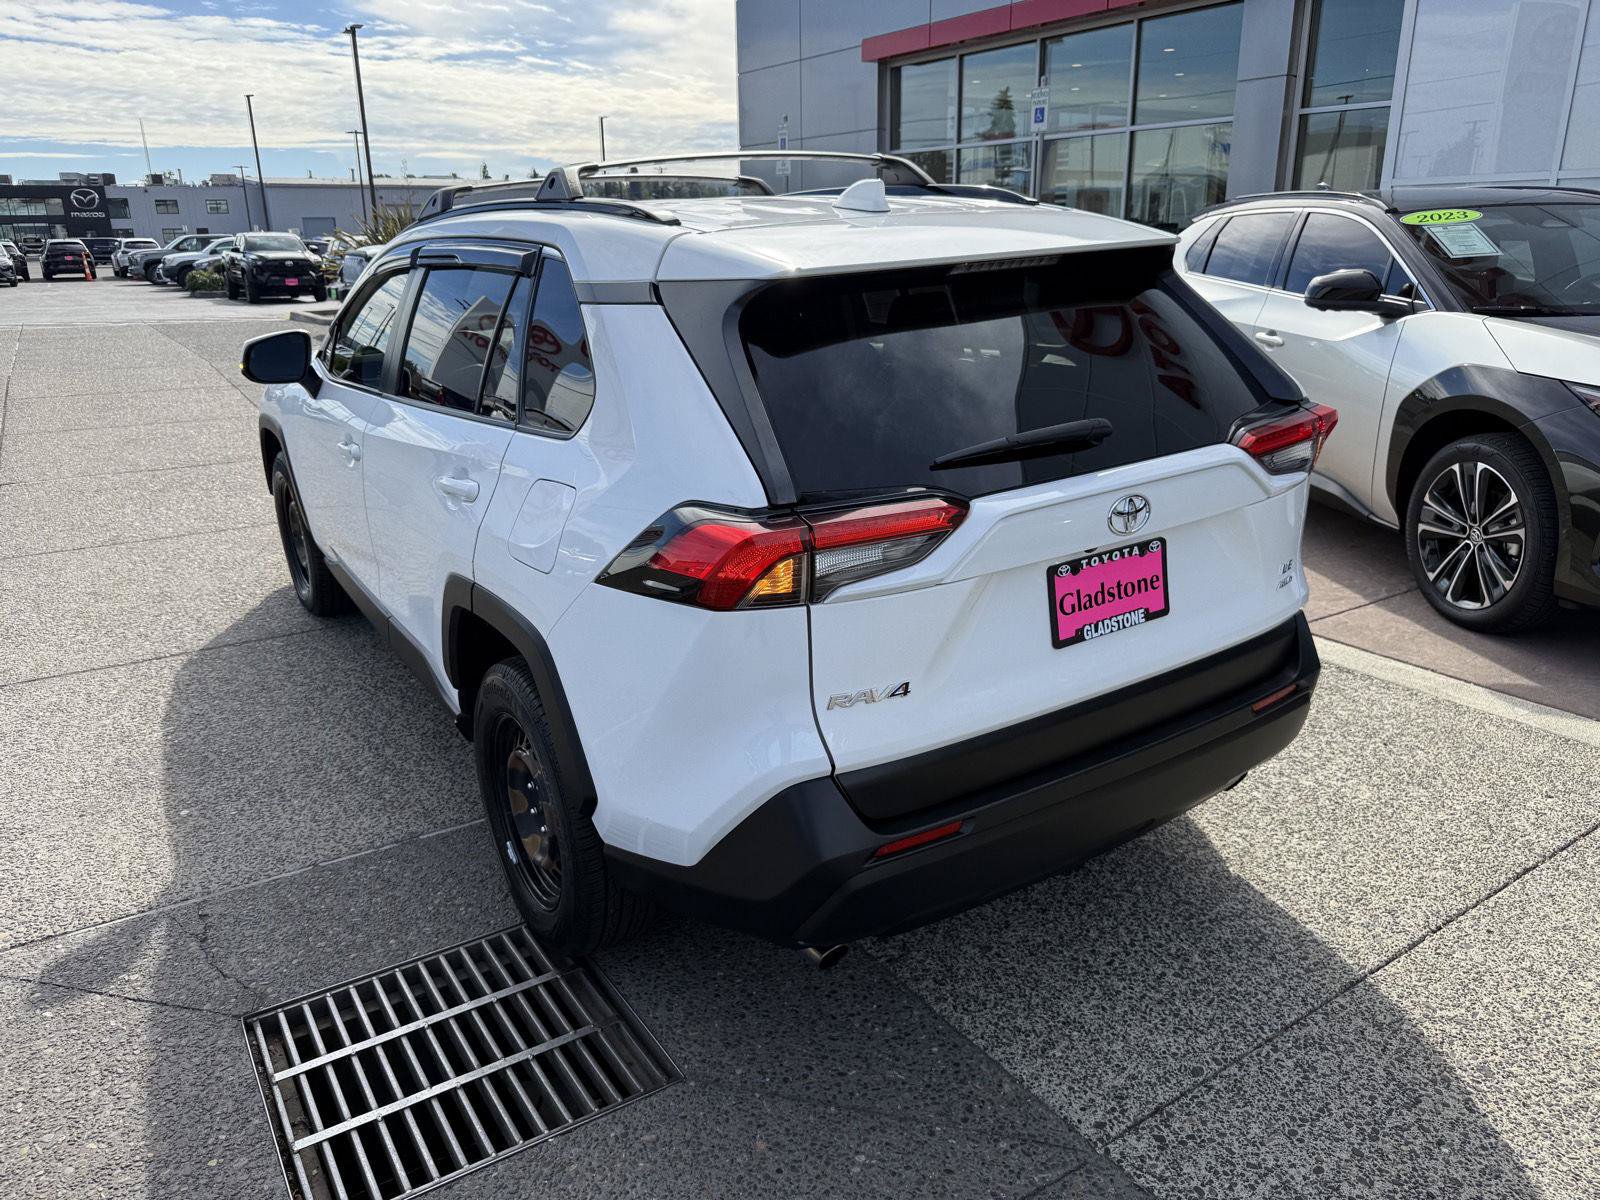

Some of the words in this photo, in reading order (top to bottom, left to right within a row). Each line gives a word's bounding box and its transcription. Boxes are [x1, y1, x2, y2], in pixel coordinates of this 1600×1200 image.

[1416, 210, 1469, 223] 2023
[1080, 545, 1140, 570] TOYOTA
[1058, 573, 1161, 616] Gladstone
[1083, 608, 1146, 640] GLADSTONE
[826, 680, 912, 711] RAV4
